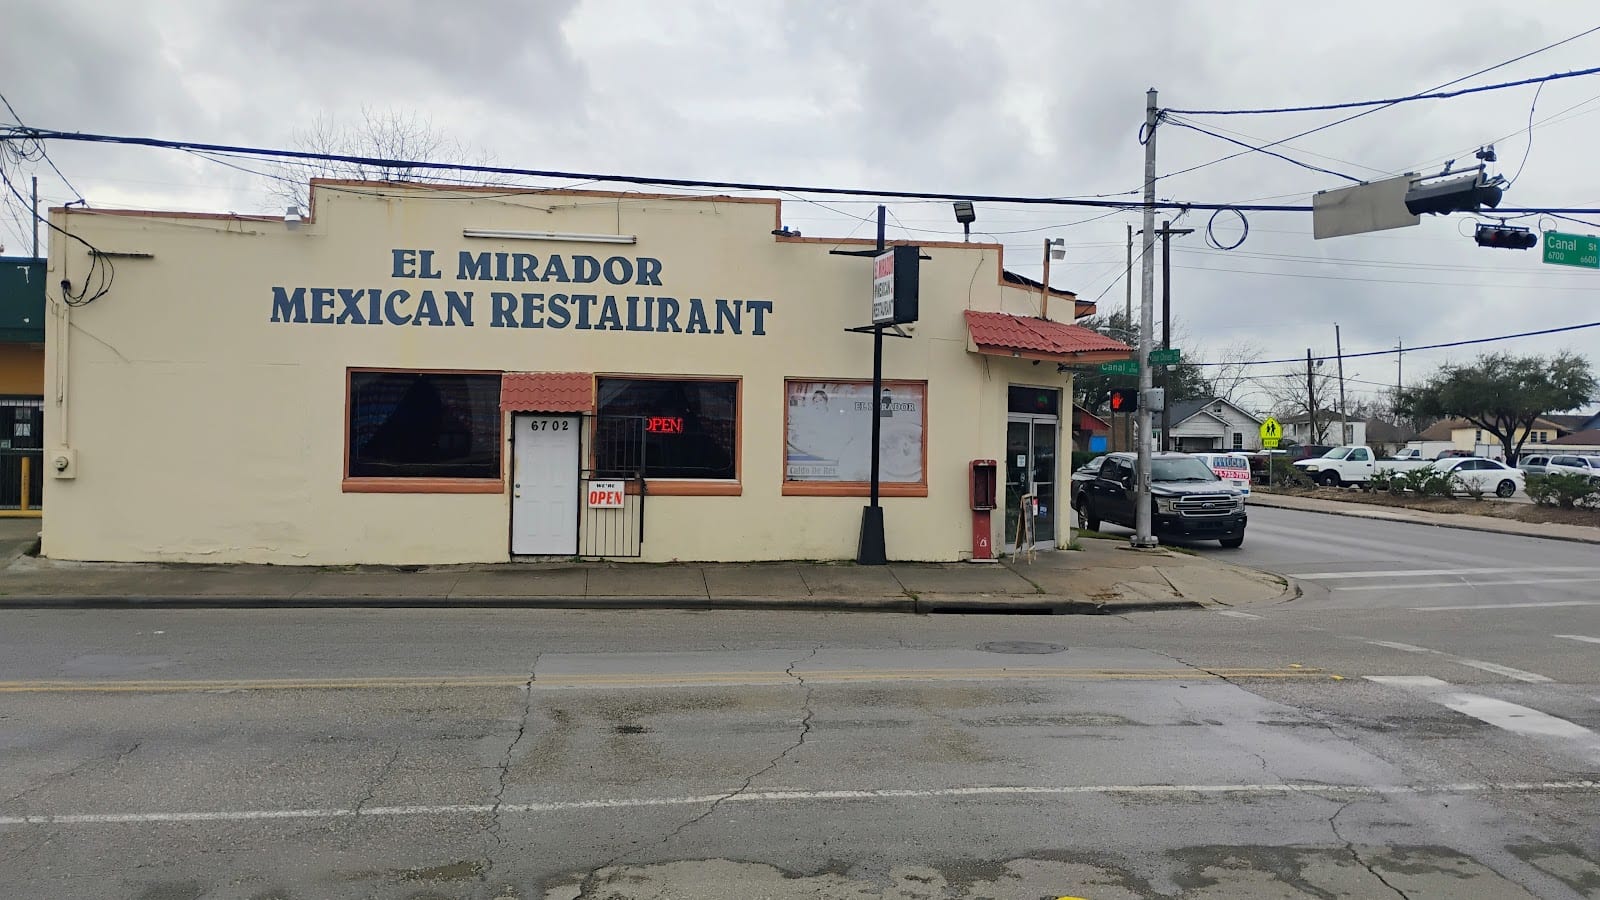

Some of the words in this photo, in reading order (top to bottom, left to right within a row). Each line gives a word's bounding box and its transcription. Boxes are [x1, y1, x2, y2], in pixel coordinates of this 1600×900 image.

[1547, 237, 1576, 250] Canal
[1548, 252, 1564, 260] 6700
[391, 249, 441, 279] EL
[456, 252, 663, 286] MIRADOR
[271, 287, 474, 327] MEXICAN
[490, 292, 773, 335] RESTAURANT
[1101, 362, 1126, 373] Canal
[854, 401, 866, 411] EL
[867, 401, 916, 412] MRADOR
[531, 420, 569, 431] 6702
[645, 417, 682, 432] OPEN
[590, 491, 622, 504] OPEN
